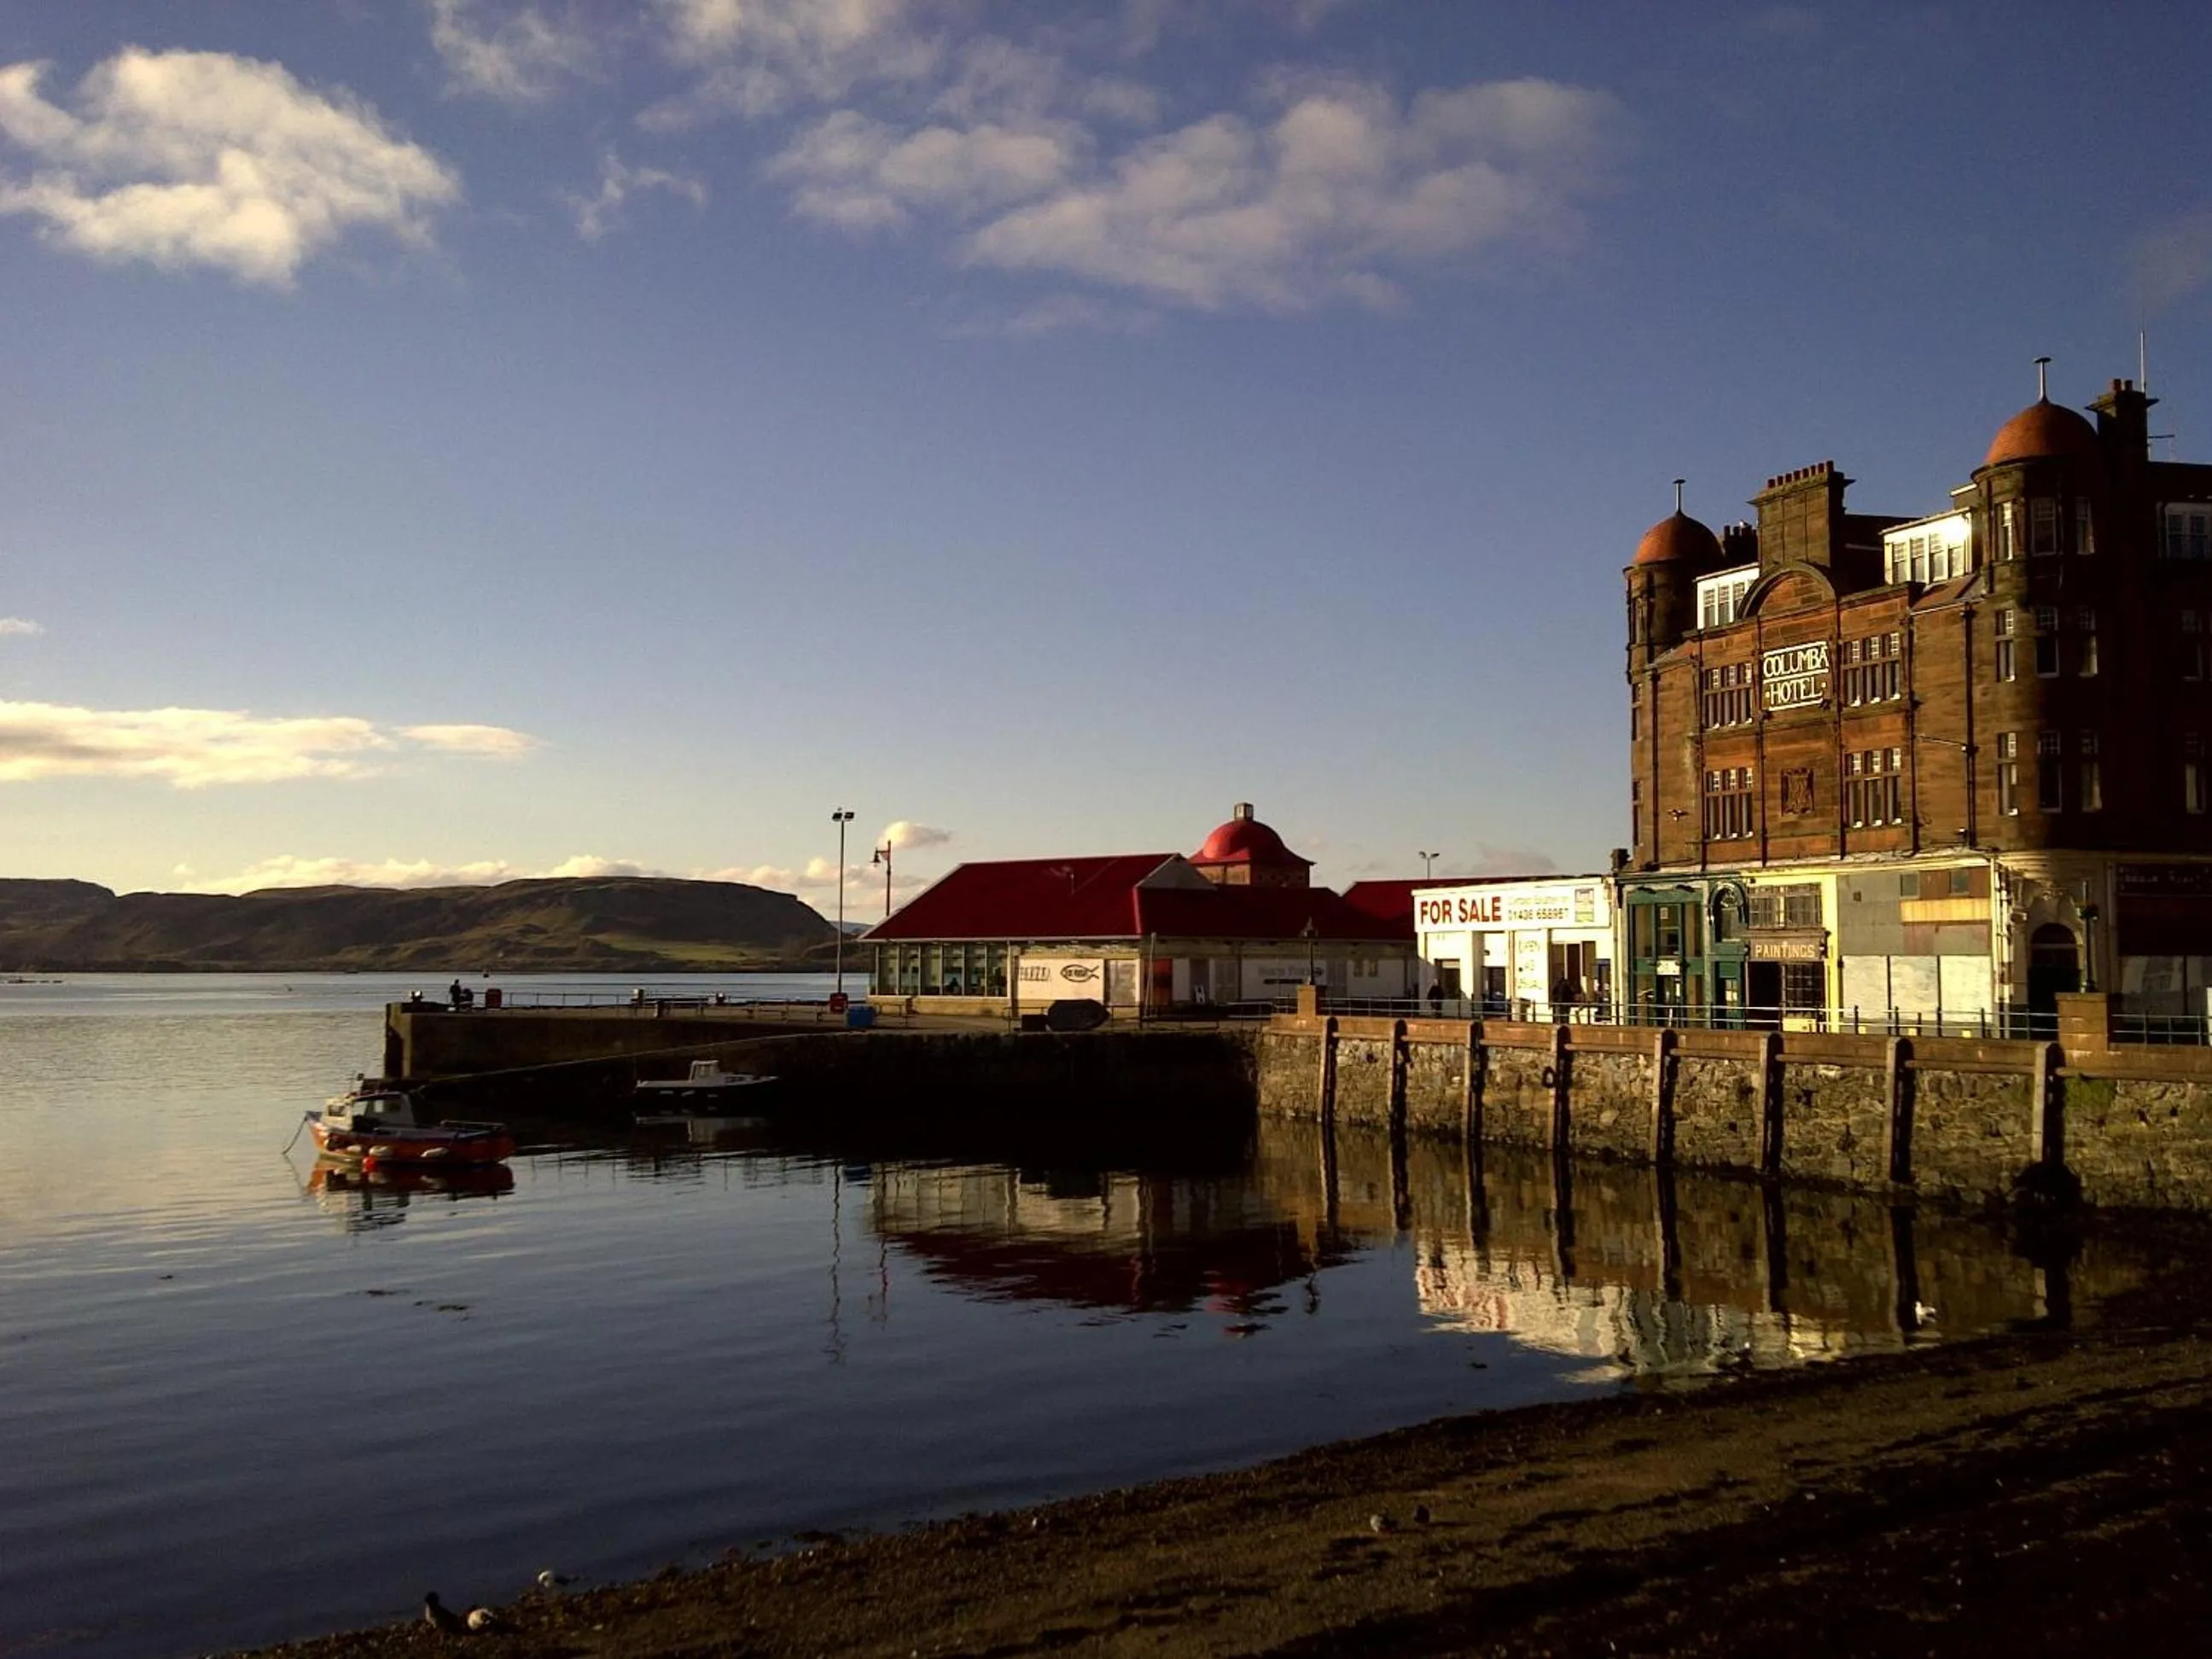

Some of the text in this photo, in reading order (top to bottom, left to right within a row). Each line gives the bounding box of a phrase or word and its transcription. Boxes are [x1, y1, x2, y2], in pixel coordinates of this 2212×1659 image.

[1763, 646, 1830, 678] COLUMBA
[1770, 677, 1823, 705] HOTEL
[1420, 896, 1502, 924] FOR SALE
[1755, 944, 1815, 958] PAINTINGS
